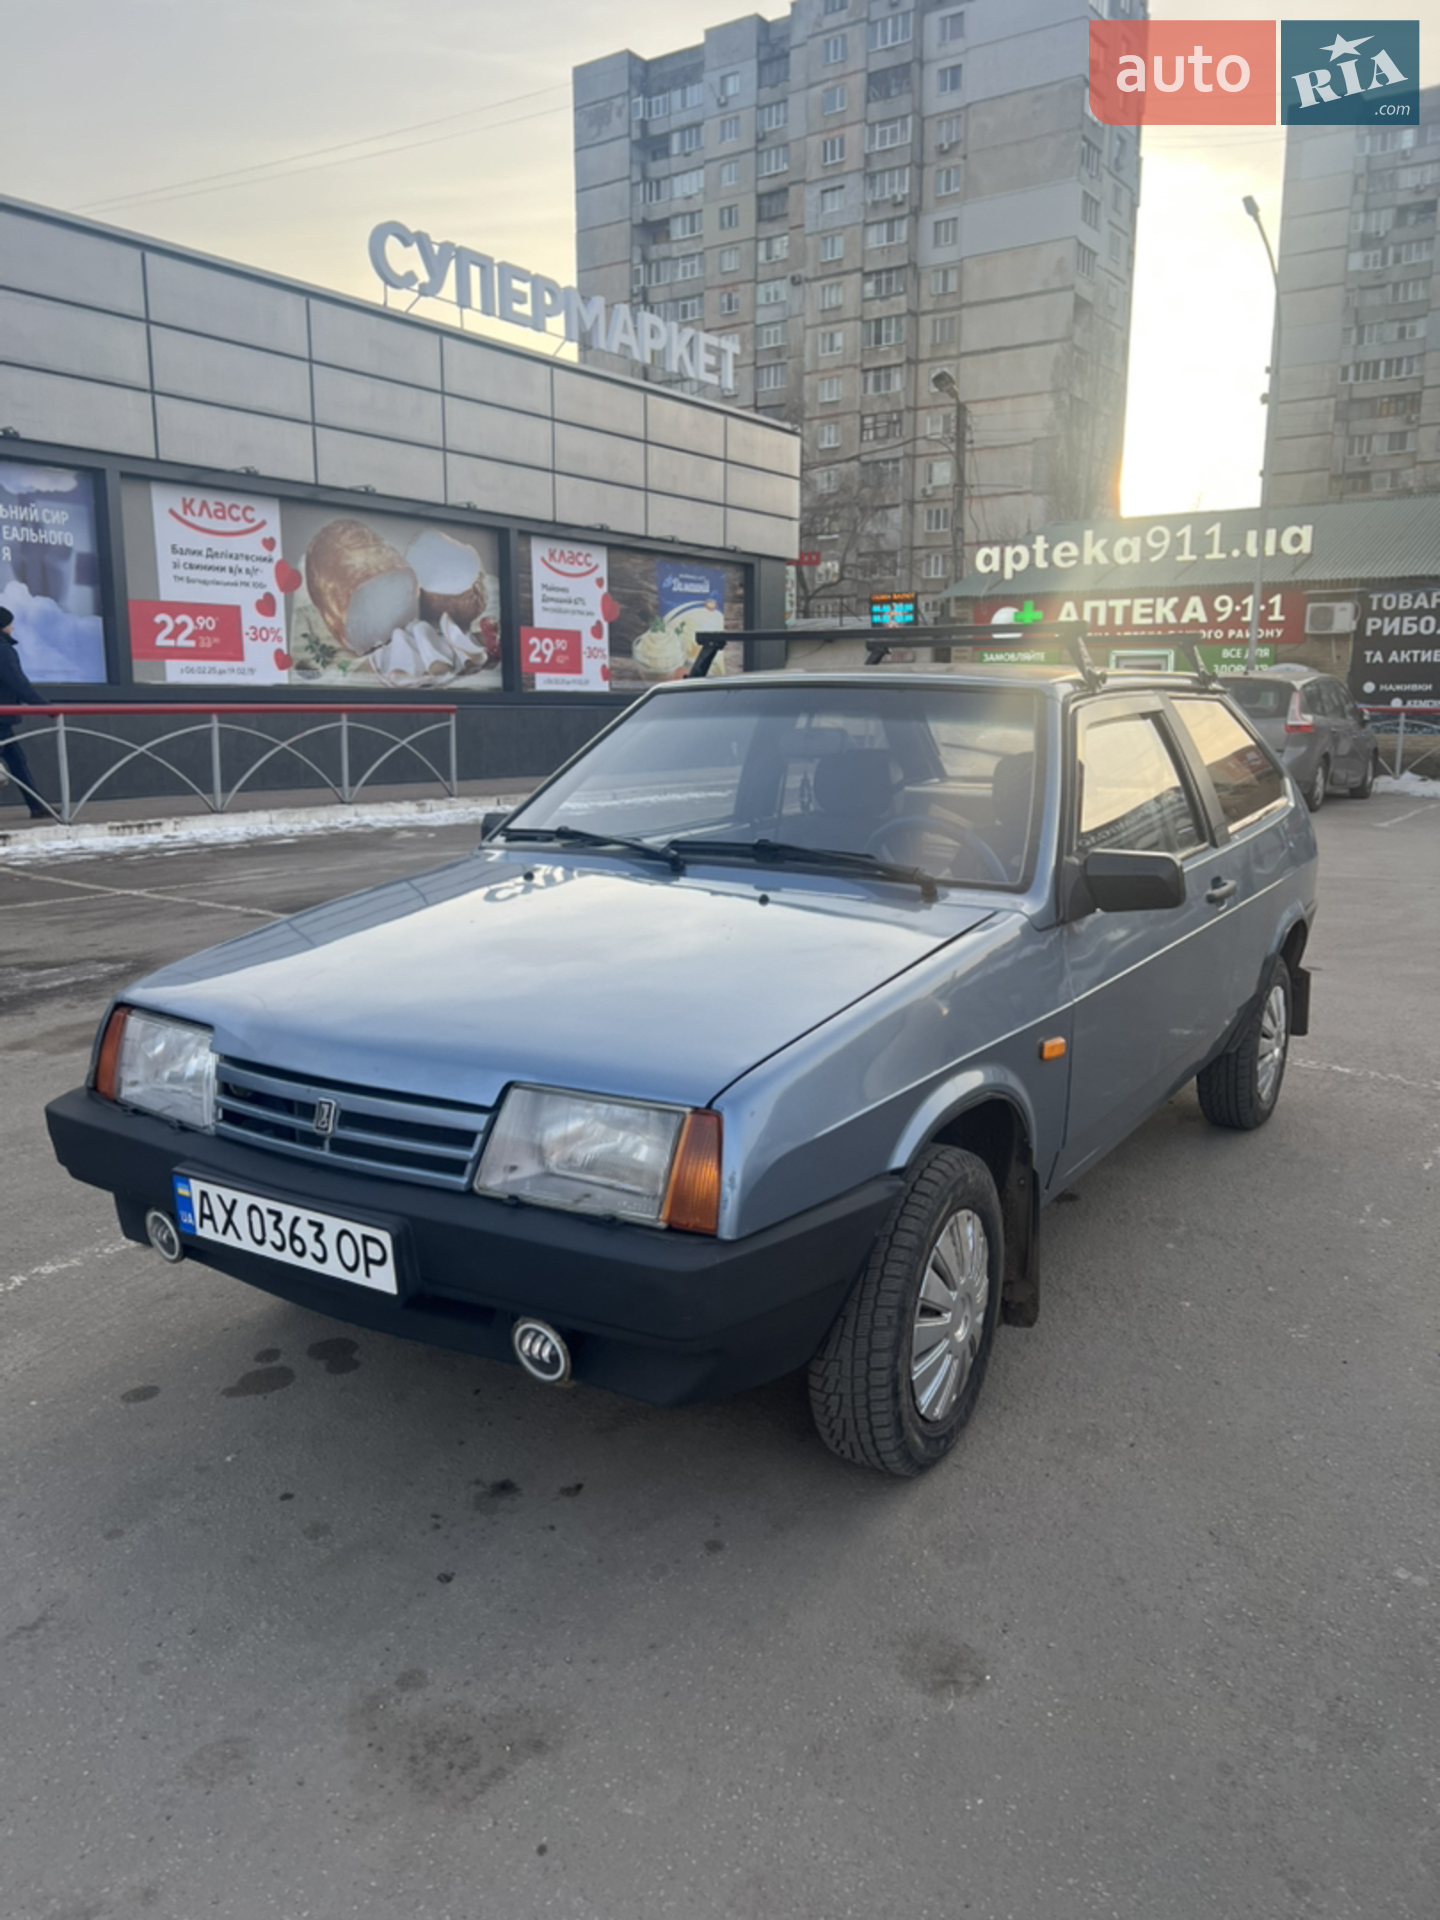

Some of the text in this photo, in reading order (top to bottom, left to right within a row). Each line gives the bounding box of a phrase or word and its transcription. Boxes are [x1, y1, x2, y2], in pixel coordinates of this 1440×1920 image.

[368, 220, 740, 391] СУПЕРМАРКЕТ
[42, 508, 69, 525] СИР
[975, 522, 1314, 580] apteka911.ua
[1058, 596, 1208, 627] АПТЕКА
[245, 626, 283, 643] -30%
[1365, 615, 1440, 636] РИБО
[1222, 648, 1242, 659] ВСЕ
[1364, 651, 1384, 664] ТА
